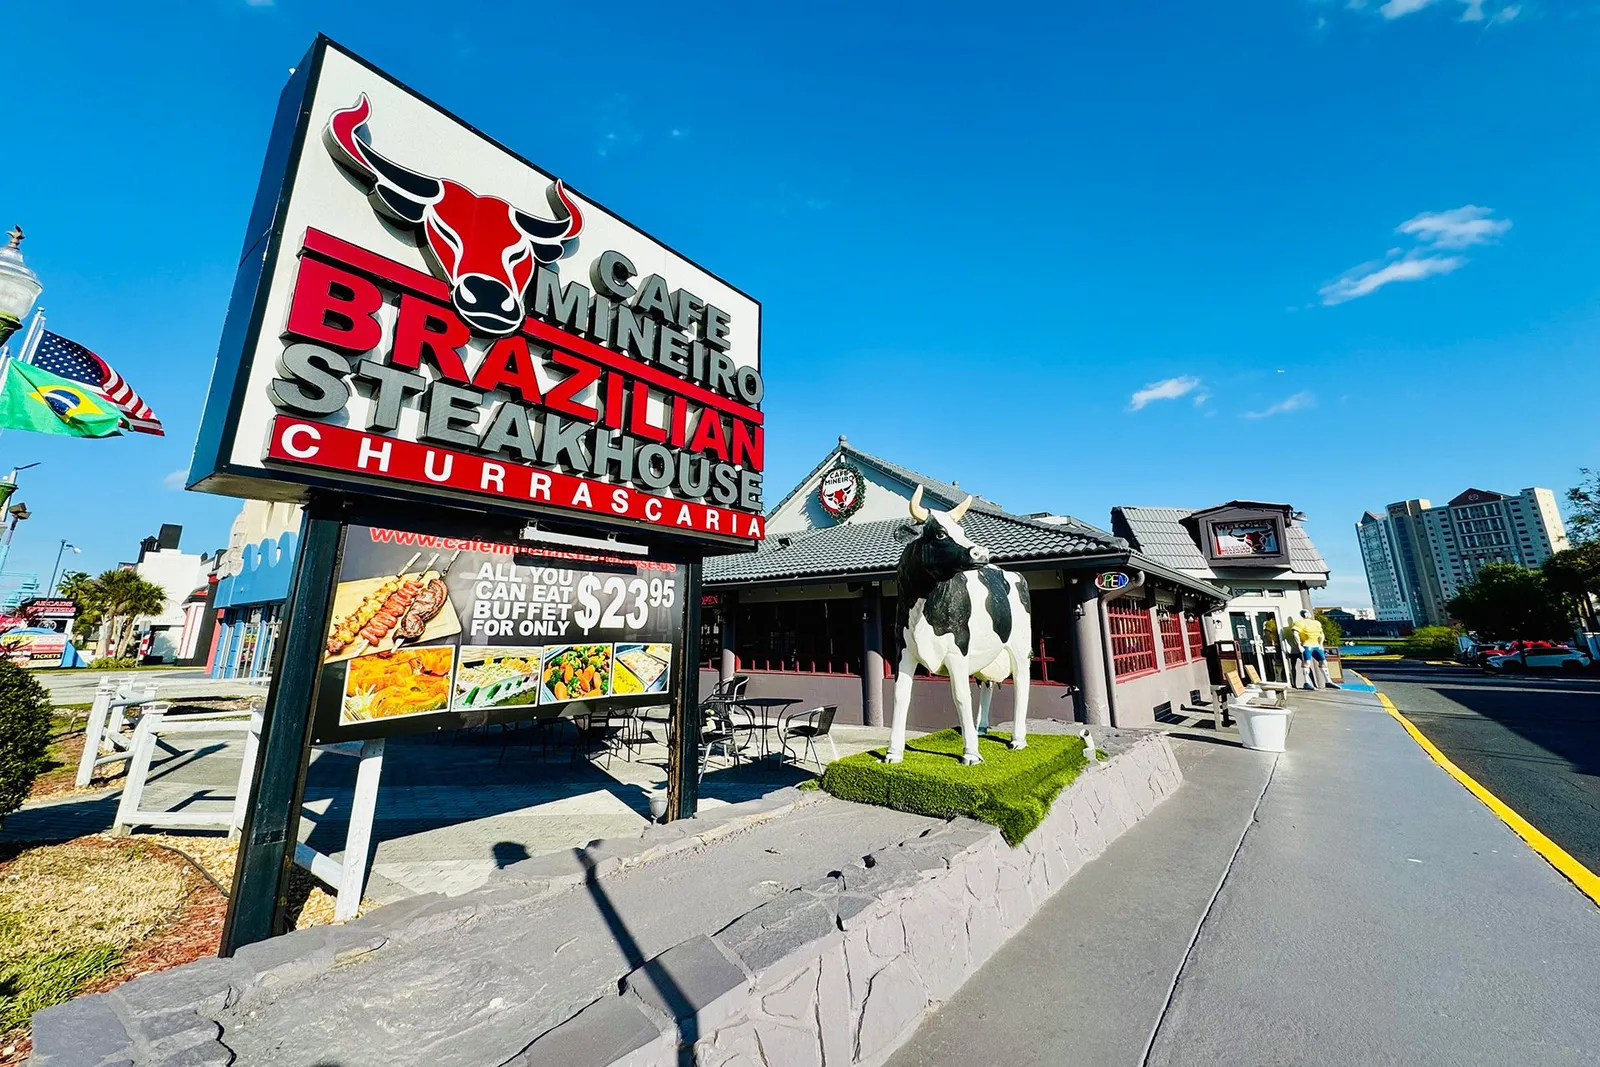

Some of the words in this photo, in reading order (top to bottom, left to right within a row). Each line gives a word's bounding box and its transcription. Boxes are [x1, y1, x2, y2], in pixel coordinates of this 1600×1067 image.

[592, 250, 731, 350] CAFE
[285, 255, 764, 472] BRAZILIAN
[534, 265, 764, 404] MINEIRO
[271, 342, 763, 511] STEAKHOUSE
[281, 423, 761, 537] CHURRASCARIA
[475, 581, 527, 600] CAN
[532, 585, 574, 603] EAT
[476, 562, 523, 583] ALL
[529, 566, 573, 586] YOU
[1097, 573, 1127, 588] OPEN
[470, 620, 514, 636] FOR
[519, 620, 571, 636] ONLY
[473, 601, 572, 621] BUFFET
